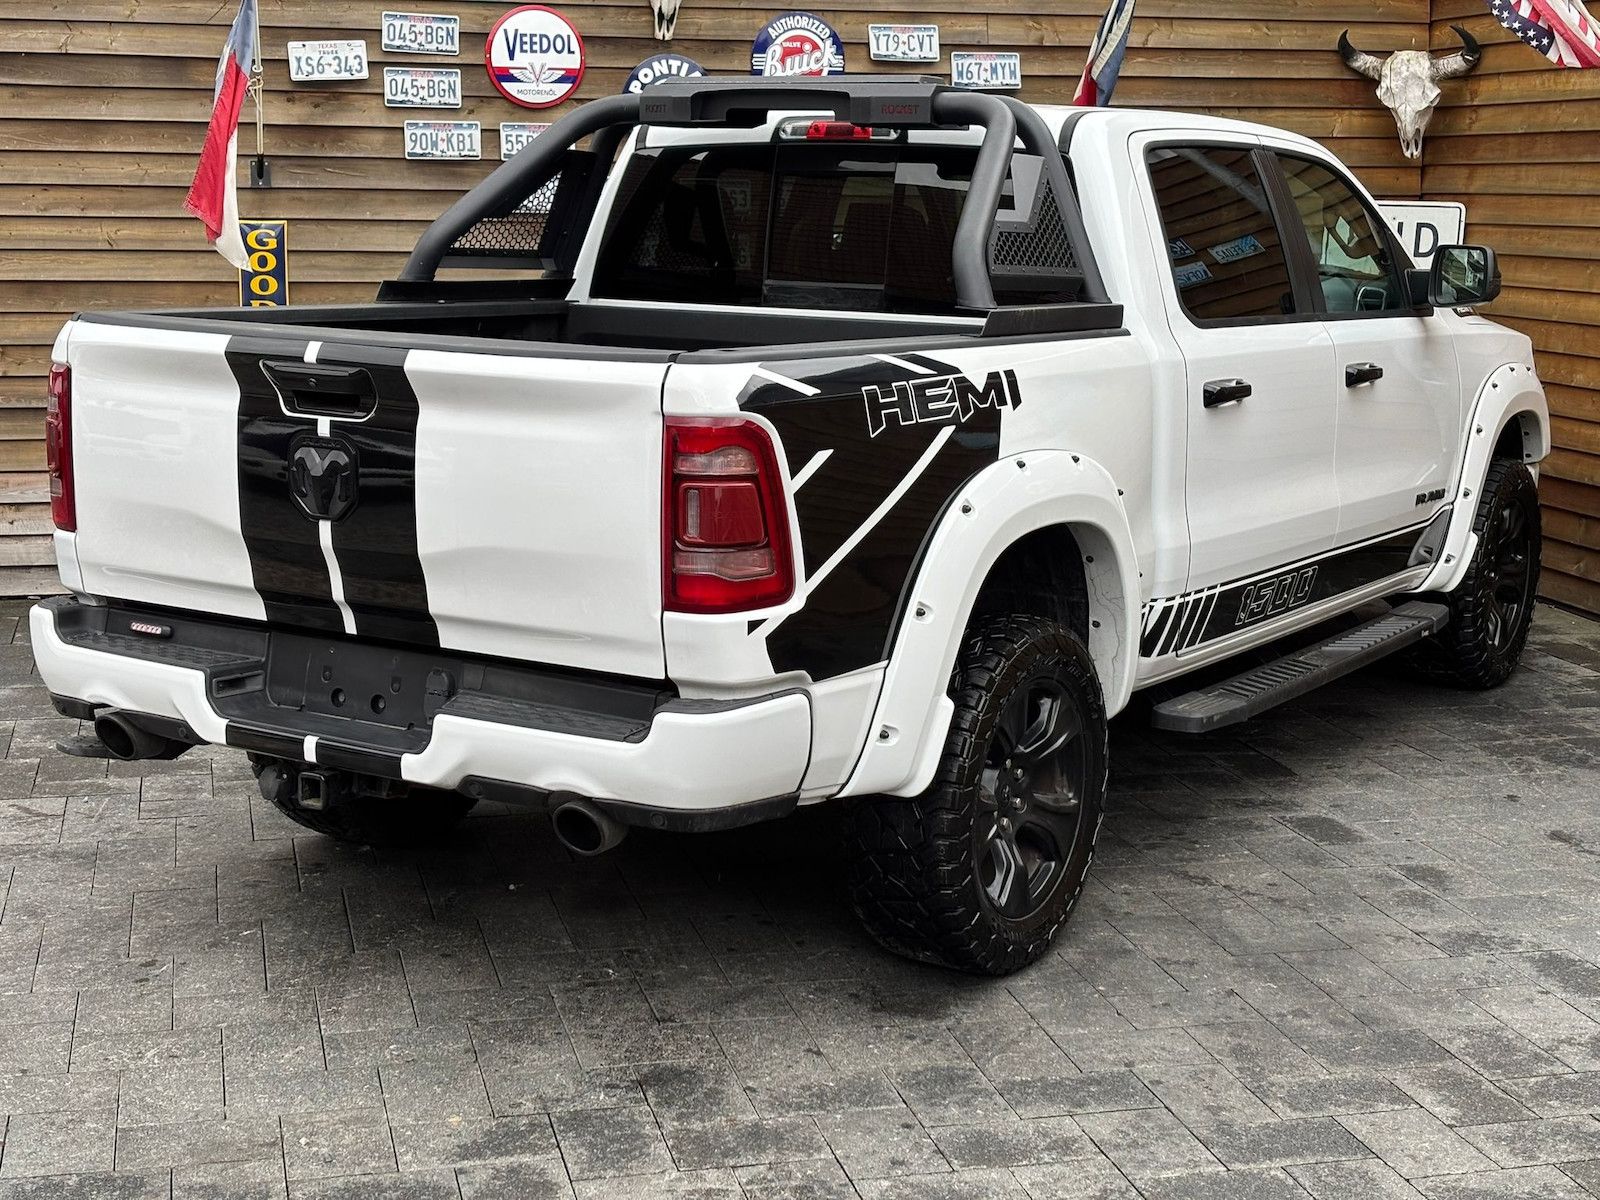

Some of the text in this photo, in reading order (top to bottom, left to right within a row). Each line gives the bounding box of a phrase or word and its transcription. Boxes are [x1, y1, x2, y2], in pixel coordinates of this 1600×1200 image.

[503, 28, 575, 61] VEEDOL
[768, 15, 831, 39] AUTHORIZED
[762, 37, 839, 76] Buick
[516, 88, 558, 96] MOTORENÖL
[628, 58, 702, 93] PONTI
[861, 368, 1023, 439] HEMI
[1234, 565, 1319, 626] 1500
